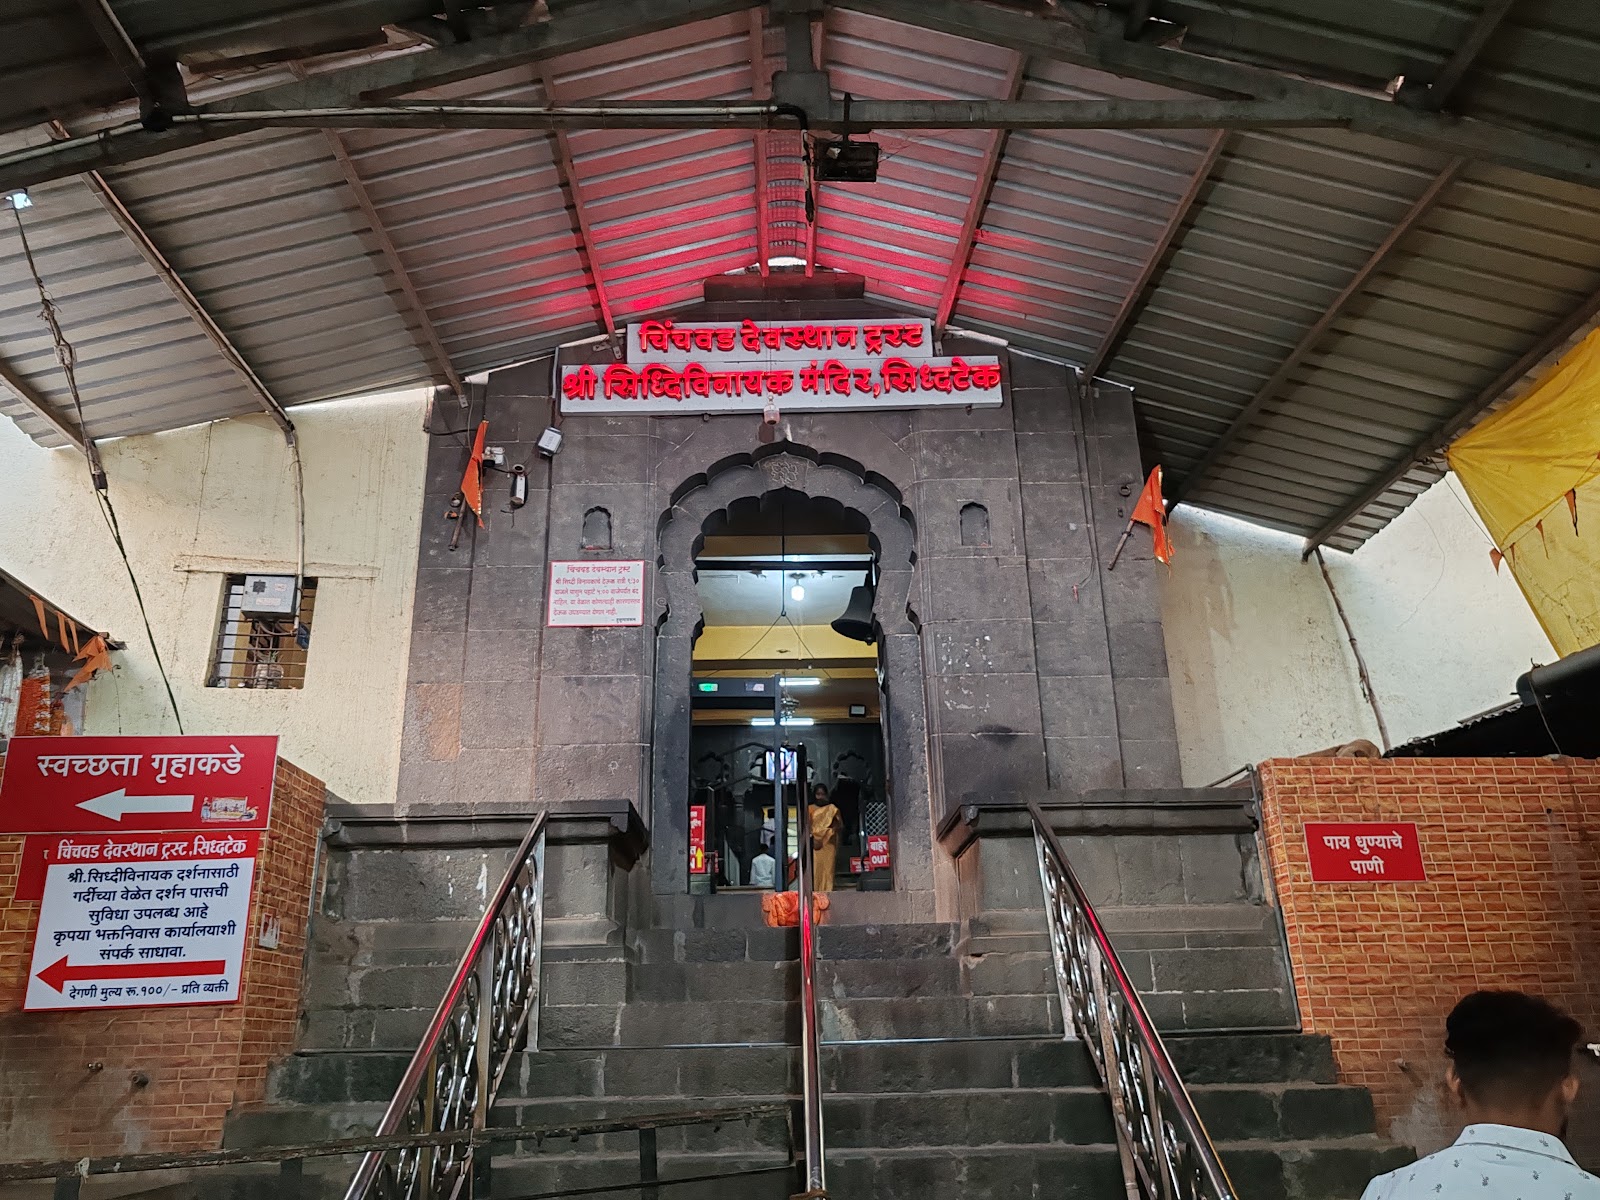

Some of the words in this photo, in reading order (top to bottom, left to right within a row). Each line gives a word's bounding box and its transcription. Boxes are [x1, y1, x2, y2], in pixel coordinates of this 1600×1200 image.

[638, 319, 736, 352] चिंचवड
[740, 318, 858, 353] देवस्थान
[863, 323, 924, 355] ट्रस्ट
[562, 363, 598, 400] श्री
[36, 753, 143, 777] स्वच्छता
[150, 744, 245, 784] गृहाकडे
[57, 839, 101, 859] चिंचवड
[103, 839, 158, 859] देवस्थान
[1322, 835, 1351, 850] पाय
[1355, 830, 1403, 855] धुण्याचे
[872, 855, 888, 864] OUT
[1349, 855, 1385, 874] पाणी
[176, 863, 240, 880] दर्शनासाठी
[120, 886, 151, 901] वेळेत
[155, 884, 186, 901] दर्शन
[189, 882, 229, 898] पासची
[88, 906, 129, 925] सुविधा
[133, 906, 180, 920] उपलब्ध
[183, 902, 209, 919] आहे
[53, 929, 92, 947] कृपया
[95, 924, 160, 941] भक्तनिवास
[164, 920, 237, 938] कार्यालयाशी
[99, 944, 135, 960] संपर्क
[69, 985, 98, 1000] देगणी
[100, 985, 123, 1001] मुल्य
